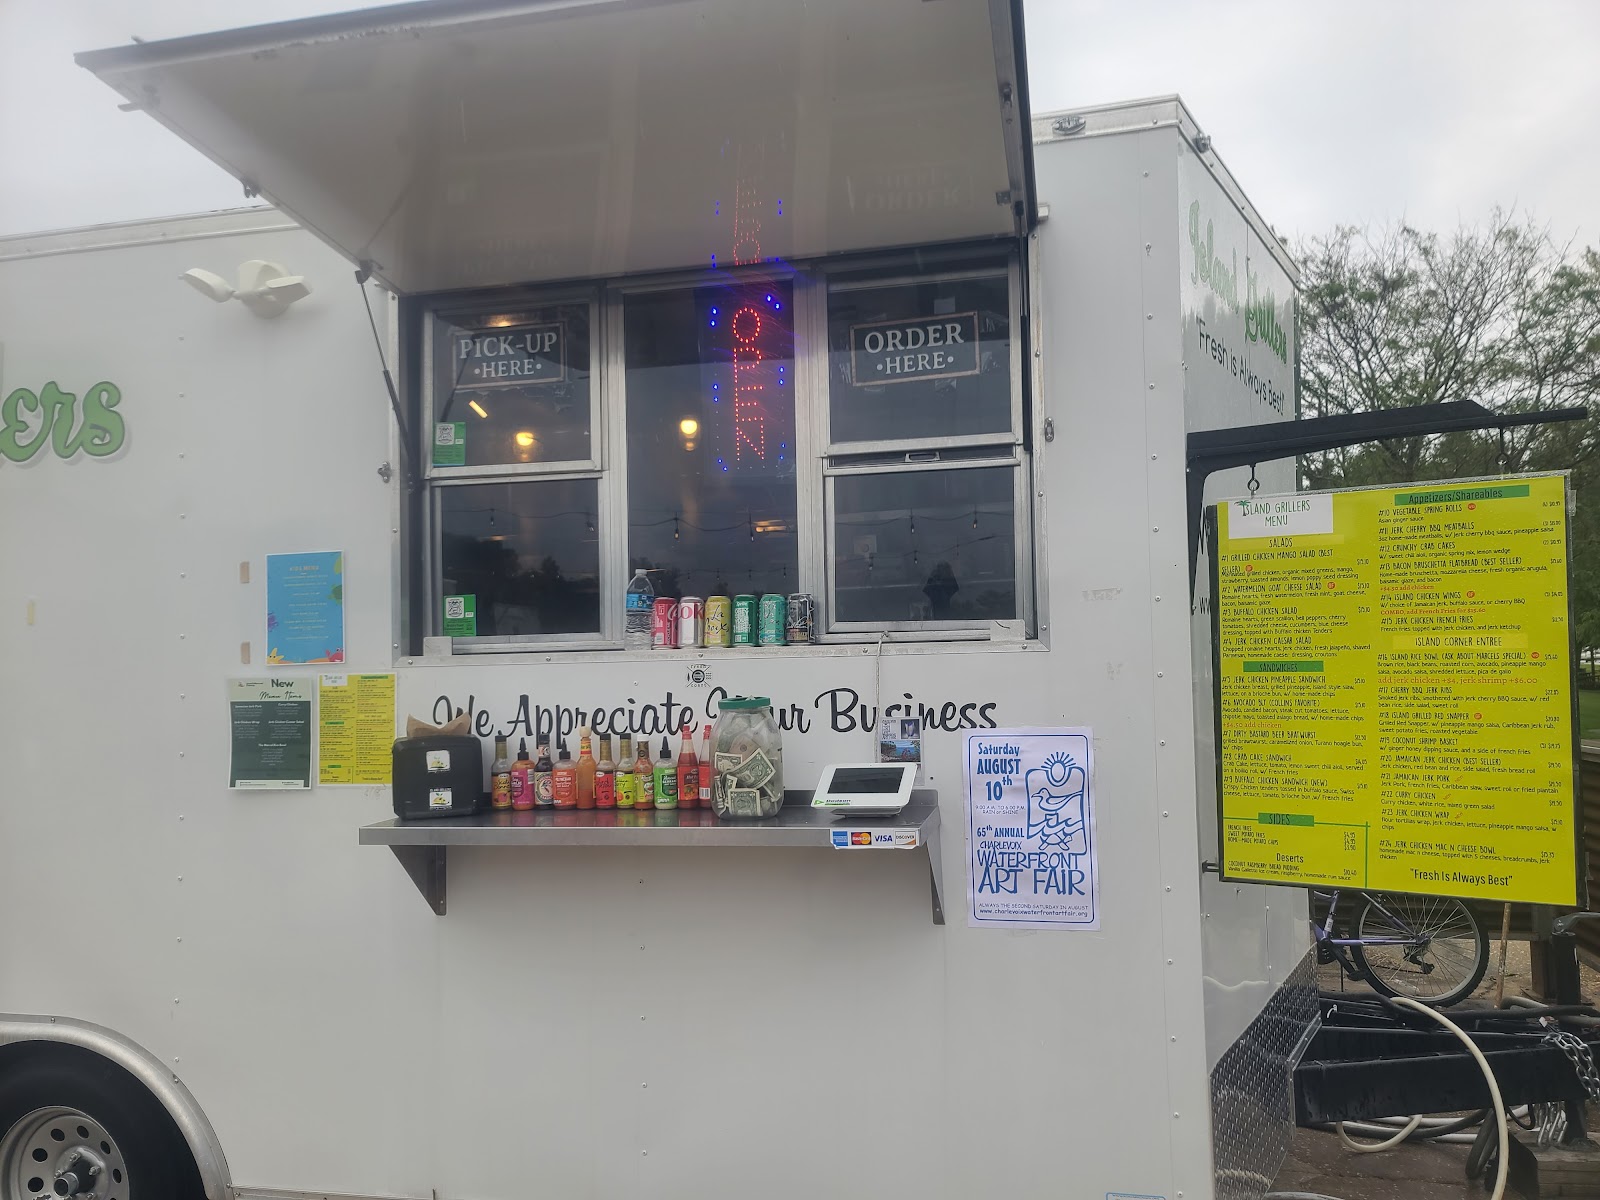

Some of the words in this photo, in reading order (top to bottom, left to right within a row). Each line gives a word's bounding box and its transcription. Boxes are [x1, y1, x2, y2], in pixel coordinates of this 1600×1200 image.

[459, 332, 557, 358] PICK-UP
[864, 323, 964, 353] ORDER
[482, 359, 534, 378] HERE
[885, 351, 945, 374] HERE
[732, 307, 765, 460] OPEN
[1231, 348, 1237, 376] is
[1240, 355, 1266, 405] Always
[0, 381, 124, 462] ers
[1409, 489, 1502, 504] Appetizers/Shareables
[1239, 501, 1270, 516] ISLAND
[1275, 500, 1310, 513] GRILLERS
[1393, 507, 1420, 516] VEGETABLE
[1424, 506, 1443, 514] SPRING
[1265, 515, 1287, 526] MENU
[1406, 525, 1426, 533] CHERRY
[1430, 524, 1441, 532] BBQ
[1444, 522, 1474, 531] MEATBALLS
[1277, 550, 1296, 559] MANGO
[1393, 561, 1411, 569] BACON
[1414, 560, 1447, 568] BRUSCHETTA
[1450, 558, 1478, 567] FLATBREAD
[1416, 637, 1440, 647] ISLAND
[1444, 637, 1473, 646] CORNER
[1477, 636, 1502, 646] ENTREE
[271, 679, 294, 687] New
[1393, 676, 1409, 685] jerk
[1461, 677, 1476, 685] jerk
[1478, 677, 1508, 686] shrimp
[432, 694, 494, 737] We
[498, 692, 698, 750] Appreciate
[978, 742, 1020, 756] Saturday
[977, 758, 1021, 775] AUGUST
[986, 775, 1012, 801] 10th
[1268, 814, 1290, 825] SIDES
[977, 825, 992, 837] 65th
[994, 828, 1024, 837] ANNUAL
[980, 841, 1022, 850] CHARLEVOIX
[1457, 844, 1476, 853] CHEESE
[1480, 845, 1496, 854] BOWL
[977, 849, 1079, 869] WATERFRONT
[1276, 853, 1303, 863] Deserts
[978, 866, 1023, 894] ART
[1033, 868, 1085, 895] FAIR
[1442, 871, 1450, 882] Is
[1452, 872, 1486, 886] Always
